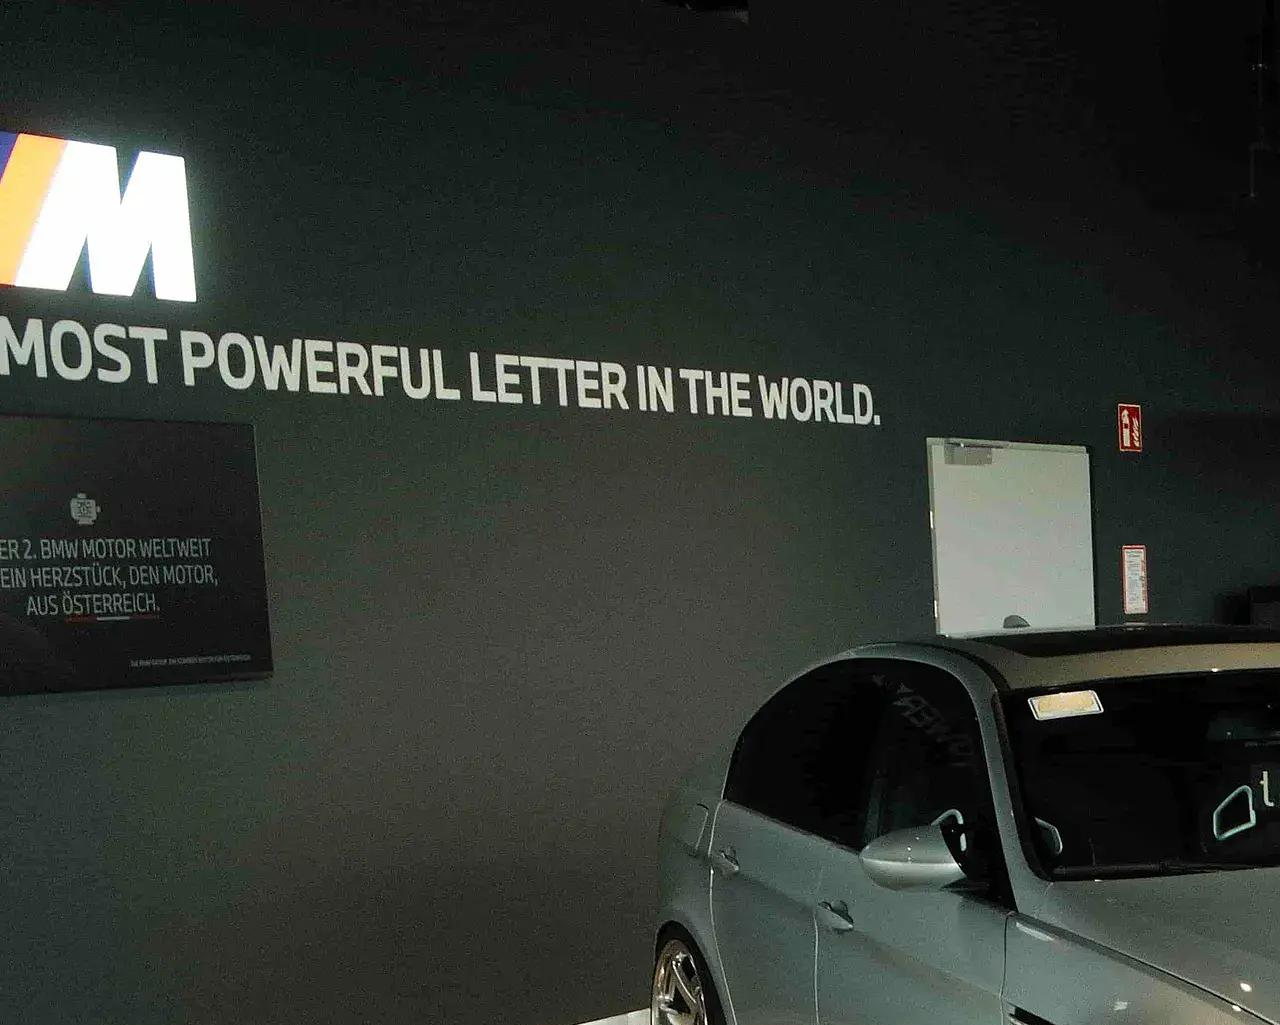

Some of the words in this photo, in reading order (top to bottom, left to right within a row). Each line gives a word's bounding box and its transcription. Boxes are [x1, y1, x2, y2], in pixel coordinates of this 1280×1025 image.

[0, 315, 168, 384] MOST
[180, 330, 461, 401] POWERFUL
[469, 351, 630, 410] LETTER
[636, 364, 674, 413] IN
[679, 368, 752, 418] THE
[757, 374, 881, 426] WORLD.
[22, 539, 37, 559] 2.
[40, 539, 79, 559] BMW
[82, 538, 136, 559] MOTOR
[139, 538, 212, 558] WELTWEIT
[30, 562, 126, 589] HERZSTÜCK,
[129, 565, 160, 585] DEN
[162, 564, 218, 587] MOTOR,
[26, 595, 58, 616] AUS
[62, 590, 161, 615] ÖSTERREICH.
